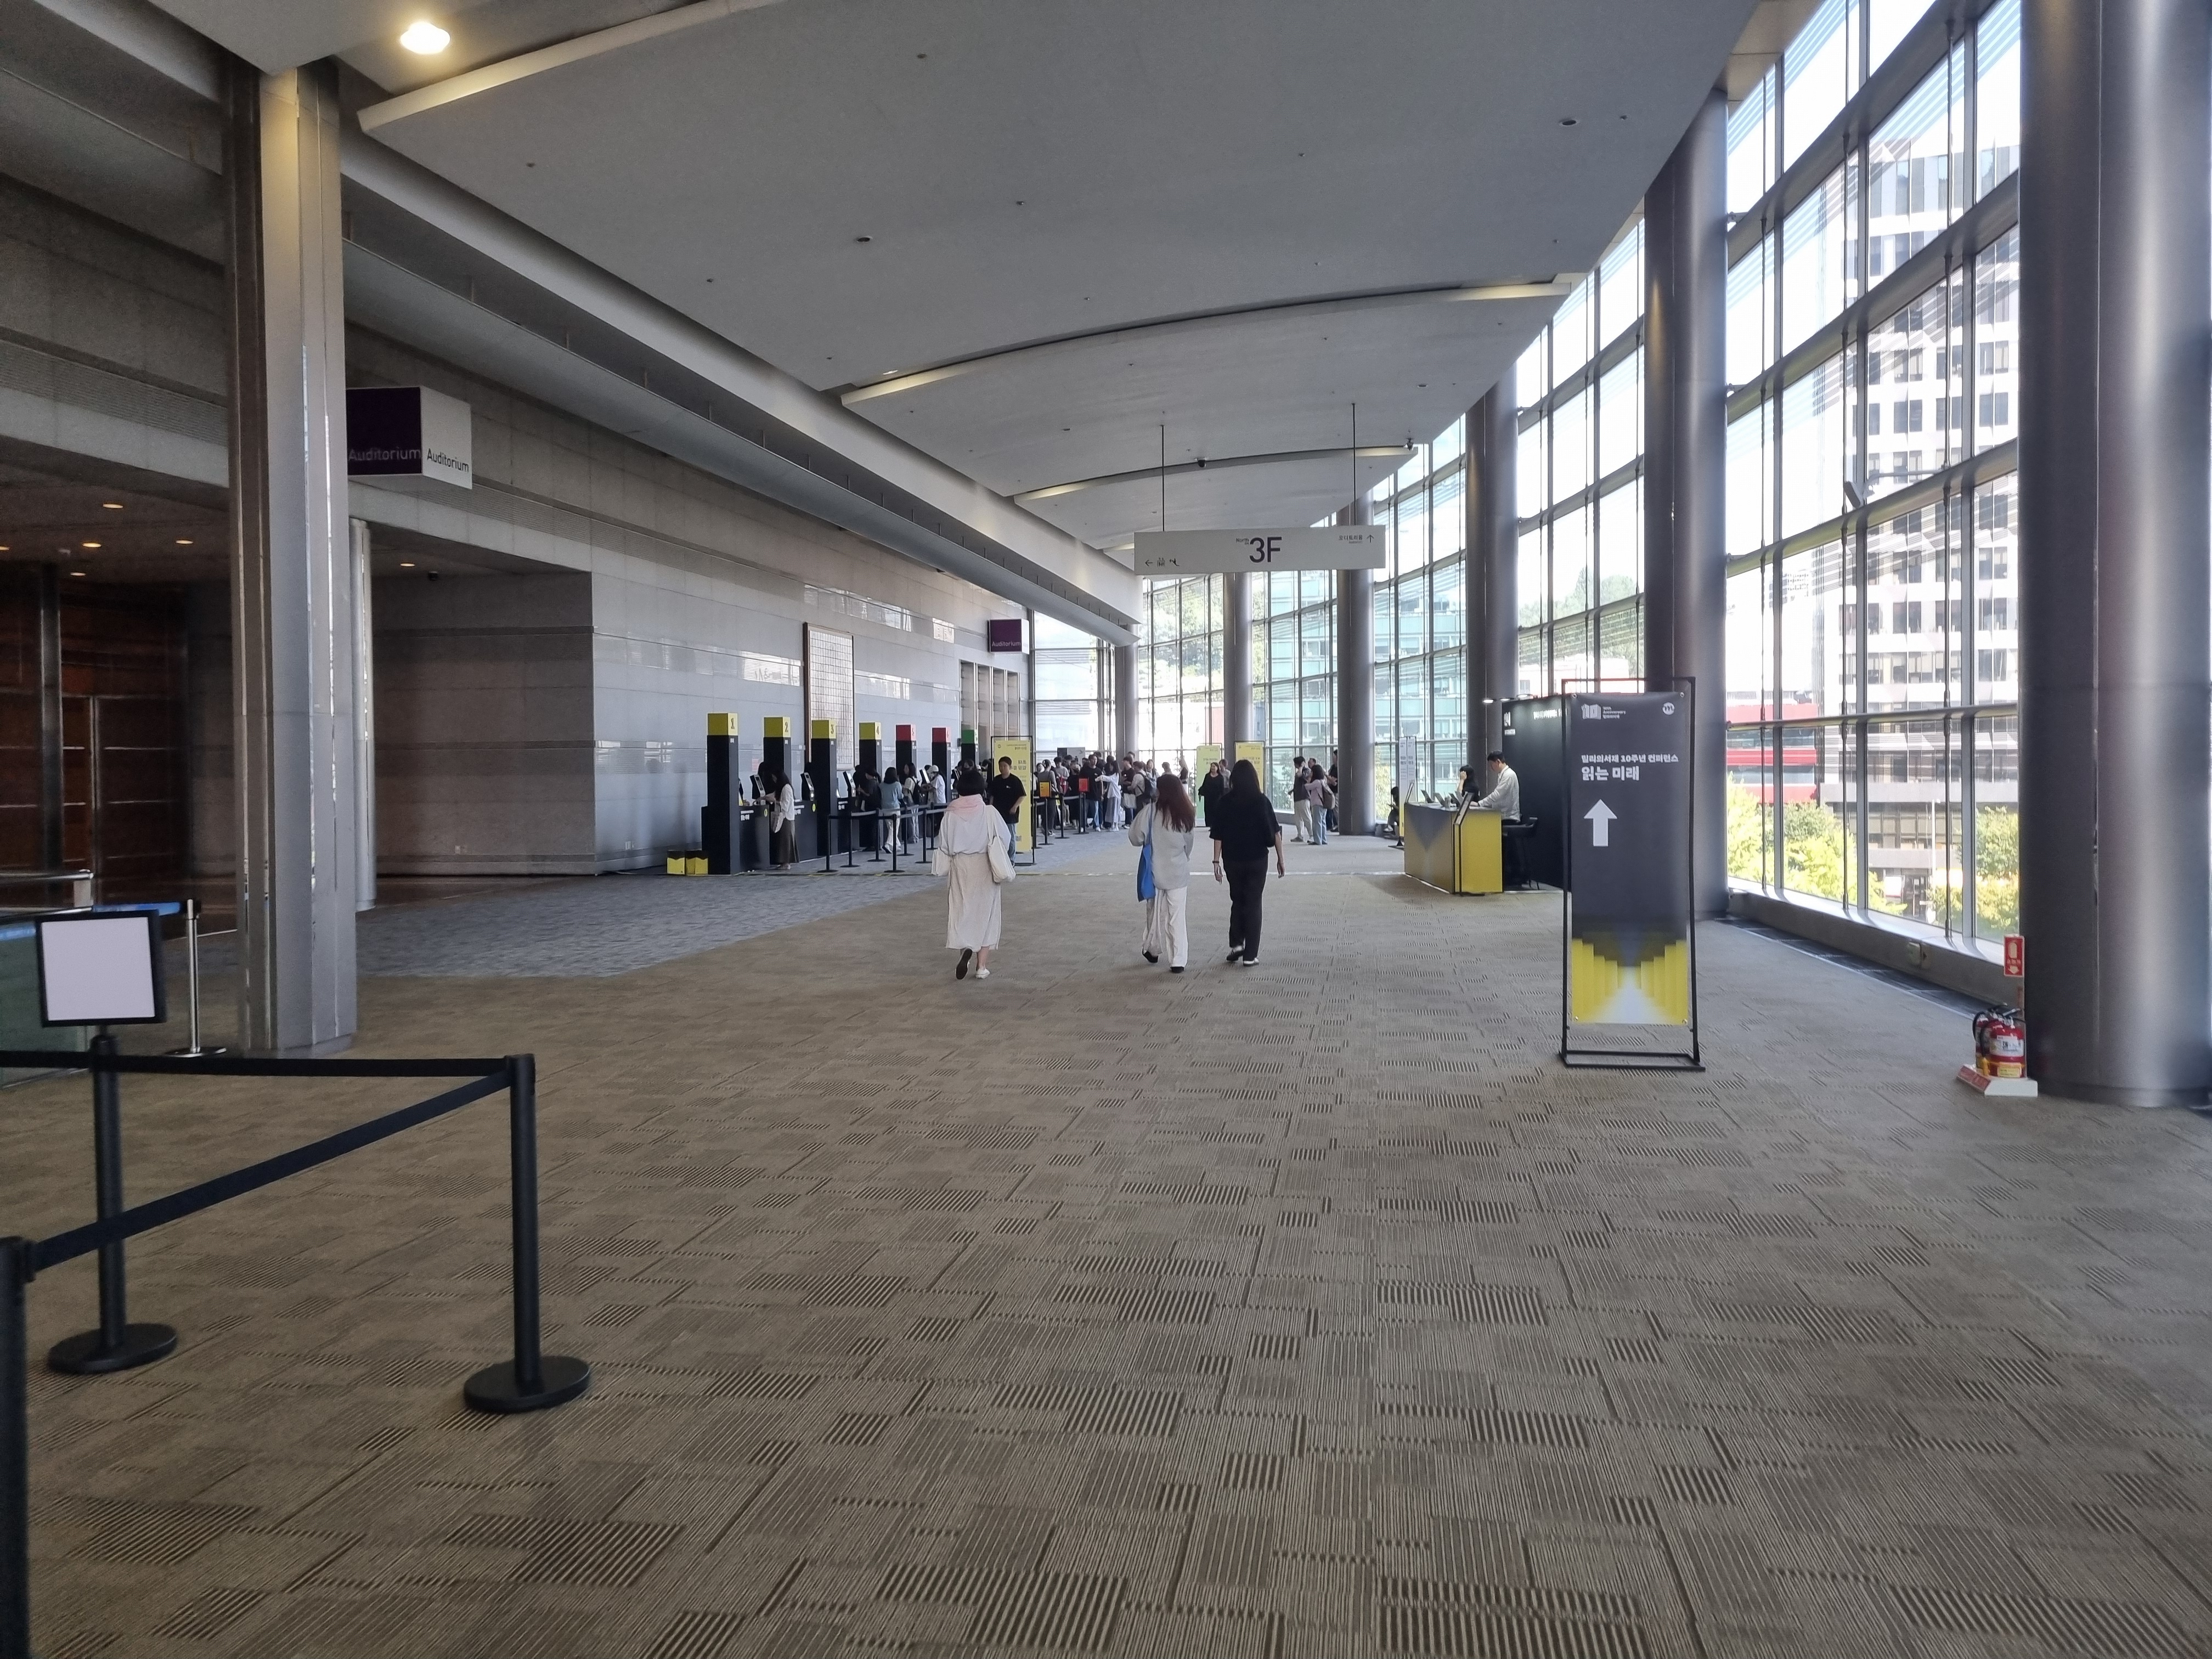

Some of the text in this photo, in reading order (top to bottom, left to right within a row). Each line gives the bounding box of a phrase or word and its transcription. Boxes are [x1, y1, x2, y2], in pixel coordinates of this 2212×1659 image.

[348, 447, 421, 461] Auditorium
[427, 448, 469, 472] Auditorium
[1249, 537, 1282, 563] 3F
[730, 718, 735, 729] 1
[785, 721, 788, 733] 2
[830, 724, 834, 735] 3
[876, 725, 879, 735] 4
[1581, 753, 1679, 763] 밀리의서재 10주년 컨퍼런스
[1581, 765, 1640, 781] 읽는 미래
